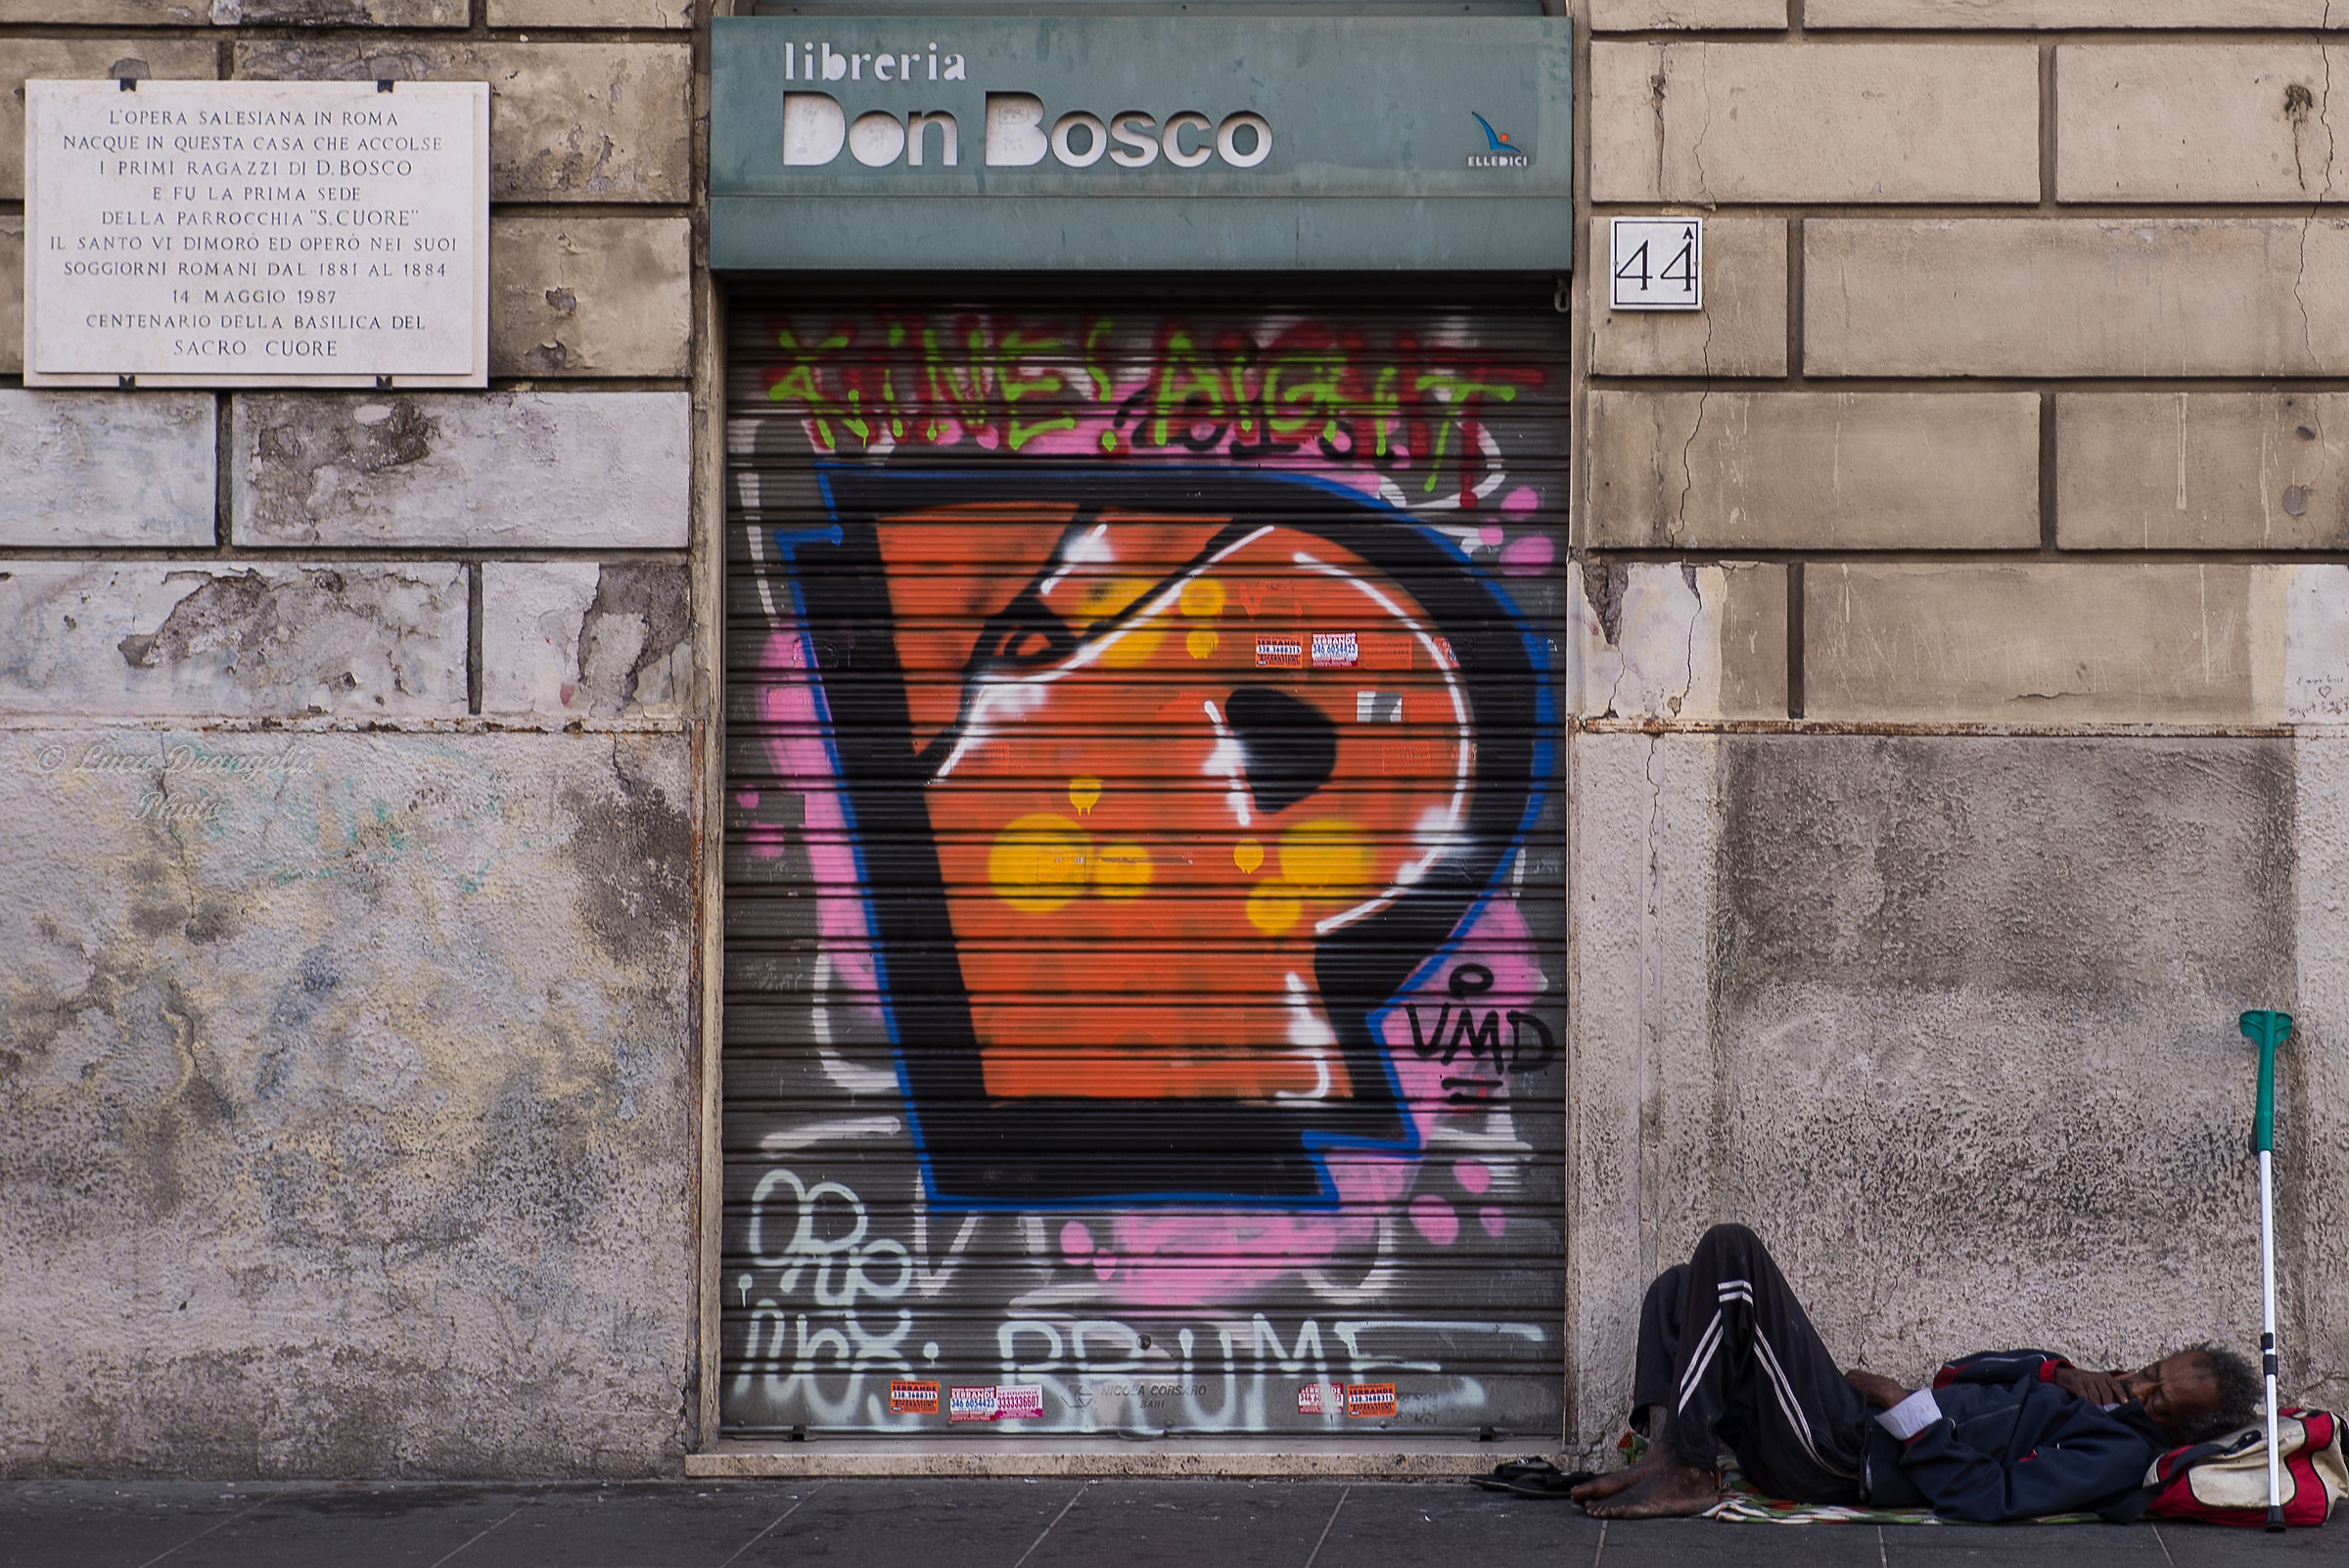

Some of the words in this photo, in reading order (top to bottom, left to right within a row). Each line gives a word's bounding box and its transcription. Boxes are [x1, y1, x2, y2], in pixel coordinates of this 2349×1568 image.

[784, 41, 968, 82] libreria
[110, 109, 188, 125] L'OPERA
[199, 110, 306, 126] SALESIANA
[314, 111, 332, 126] IN
[342, 111, 398, 126] ROMA
[782, 90, 960, 168] Don
[985, 90, 1274, 169] Bosco
[63, 134, 139, 154] NACQUE
[147, 135, 163, 151] IN
[173, 135, 245, 154] QUESTA
[253, 136, 304, 152] CASA
[313, 136, 349, 152] CHE
[356, 136, 441, 152] ACCOLSE
[100, 160, 105, 175] I
[118, 160, 174, 176] PRIMI
[187, 161, 277, 176] RAGAZZI
[289, 161, 306, 176] DI
[1467, 155, 1528, 167] ELLEDICI
[153, 186, 162, 201] E
[173, 186, 196, 202] FU
[208, 186, 234, 202] LA
[244, 186, 306, 202] PRIMA
[317, 186, 361, 202] SEDE
[102, 210, 165, 226] DELLA
[177, 210, 303, 226] PARROCCHIA
[50, 235, 67, 251] IL
[77, 236, 143, 252] SANTO
[152, 236, 172, 252] VI
[183, 232, 259, 252] DIMORÒ
[268, 236, 292, 252] ED
[299, 232, 360, 252] OPERÒ
[370, 236, 400, 252] NEI
[413, 237, 456, 253] SUOI
[64, 260, 166, 277] SOGGIORNI
[178, 261, 256, 277] ROMANI
[267, 261, 306, 277] DAL
[319, 261, 357, 277] 1881
[368, 262, 392, 277] AL
[403, 262, 445, 278] 1884
[1615, 238, 1697, 293] 44
[172, 289, 190, 303] 14
[204, 289, 286, 304] MAGGIO
[298, 289, 337, 304] 1987
[85, 313, 211, 329] CENTENARIO
[220, 314, 283, 330] DELLA
[294, 314, 382, 330] BASILICA
[392, 314, 426, 331] DEL
[173, 339, 247, 356] SACRO
[265, 340, 338, 357] CUORE
[1313, 644, 1325, 654] 346
[1326, 644, 1357, 654] 6054423
[1100, 1384, 1145, 1397] NICOLA
[1150, 1384, 1207, 1398] CORSARO
[1349, 1387, 1393, 1396] SERRANDE
[951, 1398, 964, 1408] 346
[965, 1398, 995, 1408] 6054423
[1139, 1400, 1165, 1408] BARI
